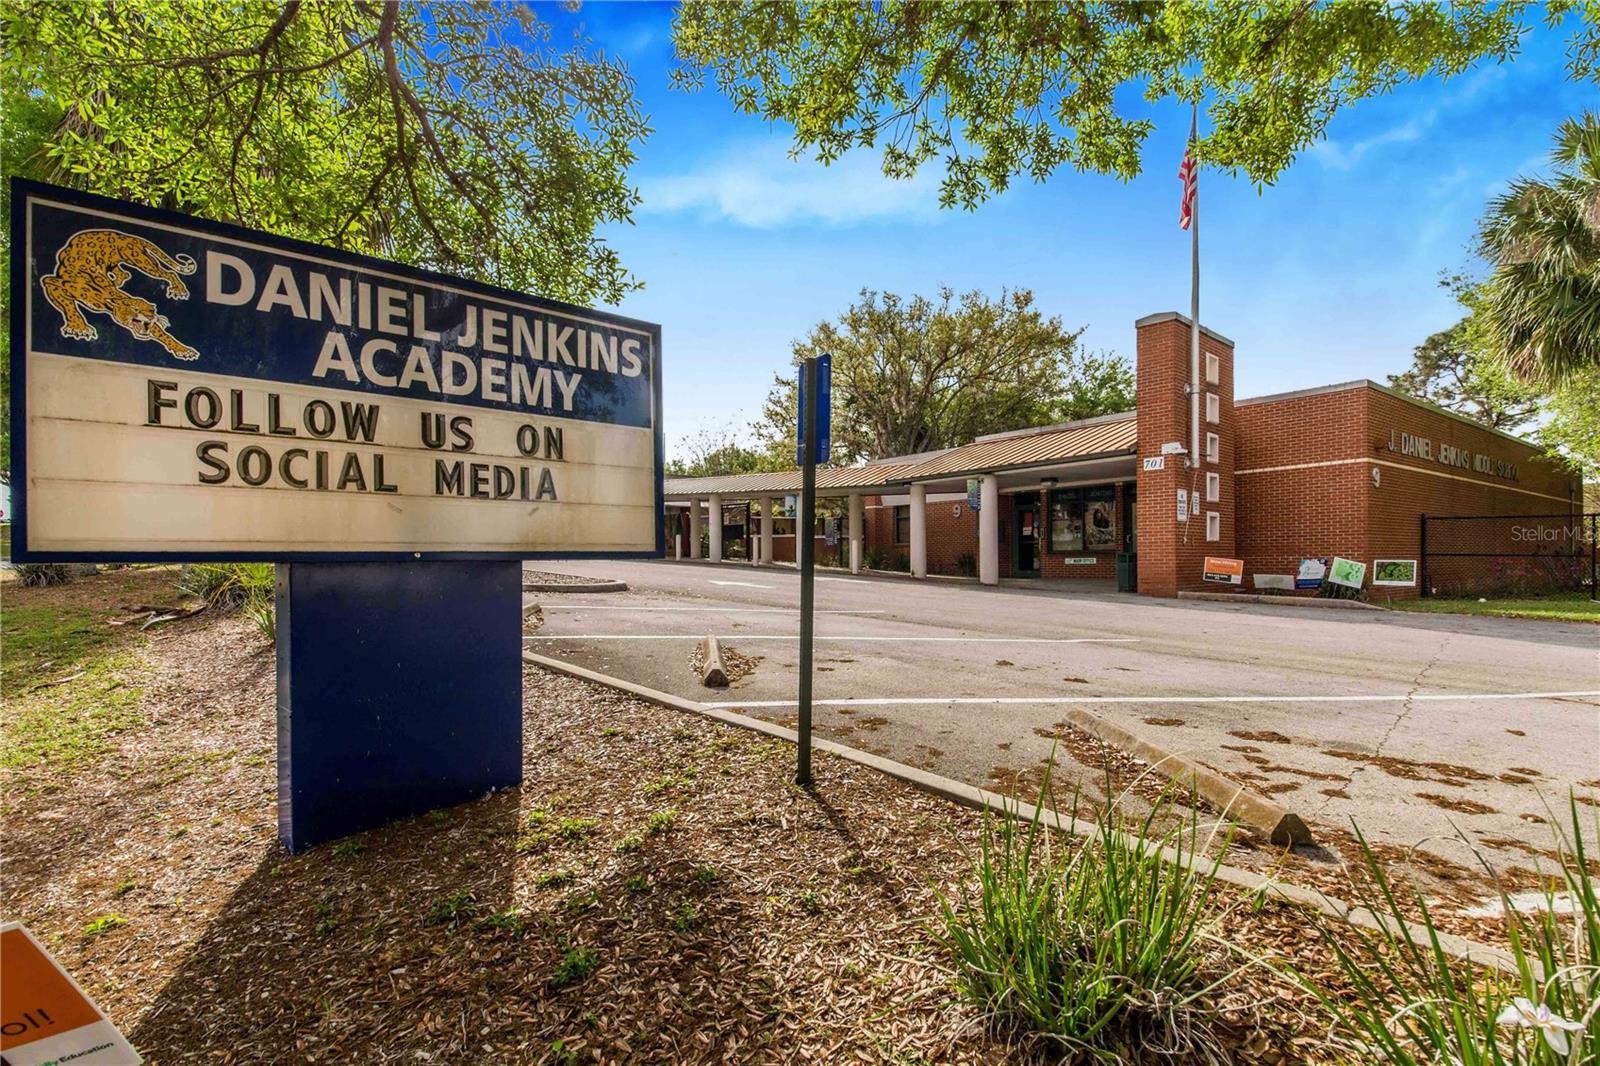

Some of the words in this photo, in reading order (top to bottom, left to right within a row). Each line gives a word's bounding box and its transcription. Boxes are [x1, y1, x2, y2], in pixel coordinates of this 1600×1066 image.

[206, 250, 441, 342] DANIEL
[457, 304, 643, 378] JENKINS
[311, 331, 582, 411] ACADEMY
[147, 379, 380, 442] FOLLOW
[421, 411, 475, 452] US
[516, 424, 564, 460] ON
[1387, 429, 1399, 452] J.
[1401, 432, 1434, 461] DANIEL
[195, 440, 398, 493] SOCIAL
[435, 459, 558, 501] MEDIA
[1144, 458, 1163, 469] 701
[1372, 467, 1381, 488] 9
[953, 504, 962, 518] 9
[59, 1042, 114, 1063] Education
